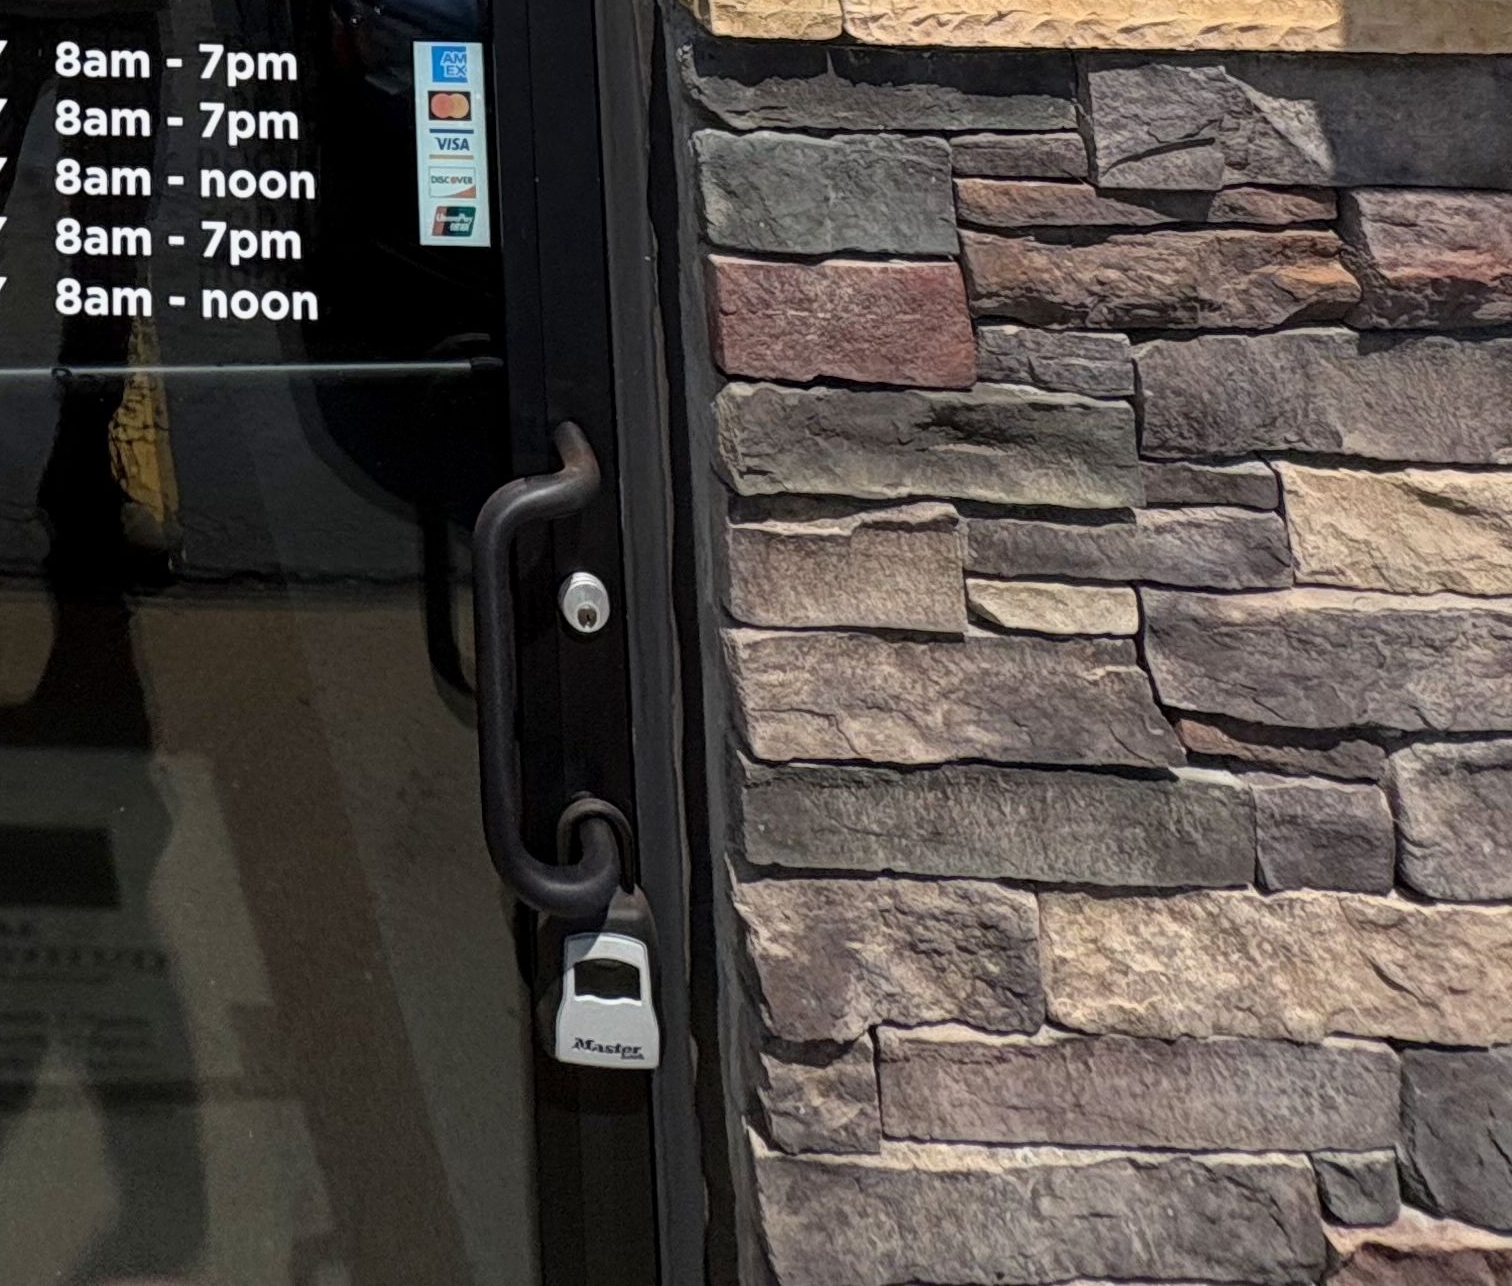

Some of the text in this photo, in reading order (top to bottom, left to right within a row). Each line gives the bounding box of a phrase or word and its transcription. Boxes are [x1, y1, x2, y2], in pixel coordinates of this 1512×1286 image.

[55, 41, 150, 78] 8am
[166, 58, 183, 68] -
[198, 43, 298, 87] 7pm
[55, 99, 151, 137] 8am
[166, 116, 184, 127] -
[199, 101, 299, 147] 7pm
[436, 137, 470, 151] VISA
[55, 158, 151, 196] 8am
[167, 175, 184, 186] -
[200, 169, 316, 200] noon
[431, 175, 473, 184] DISCOVER
[55, 217, 152, 256] 8am
[168, 235, 185, 246] -
[201, 220, 302, 265] 7pm
[55, 277, 152, 317] 8am
[168, 295, 186, 306] -
[202, 289, 319, 321] noon
[572, 1037, 642, 1054] Master
